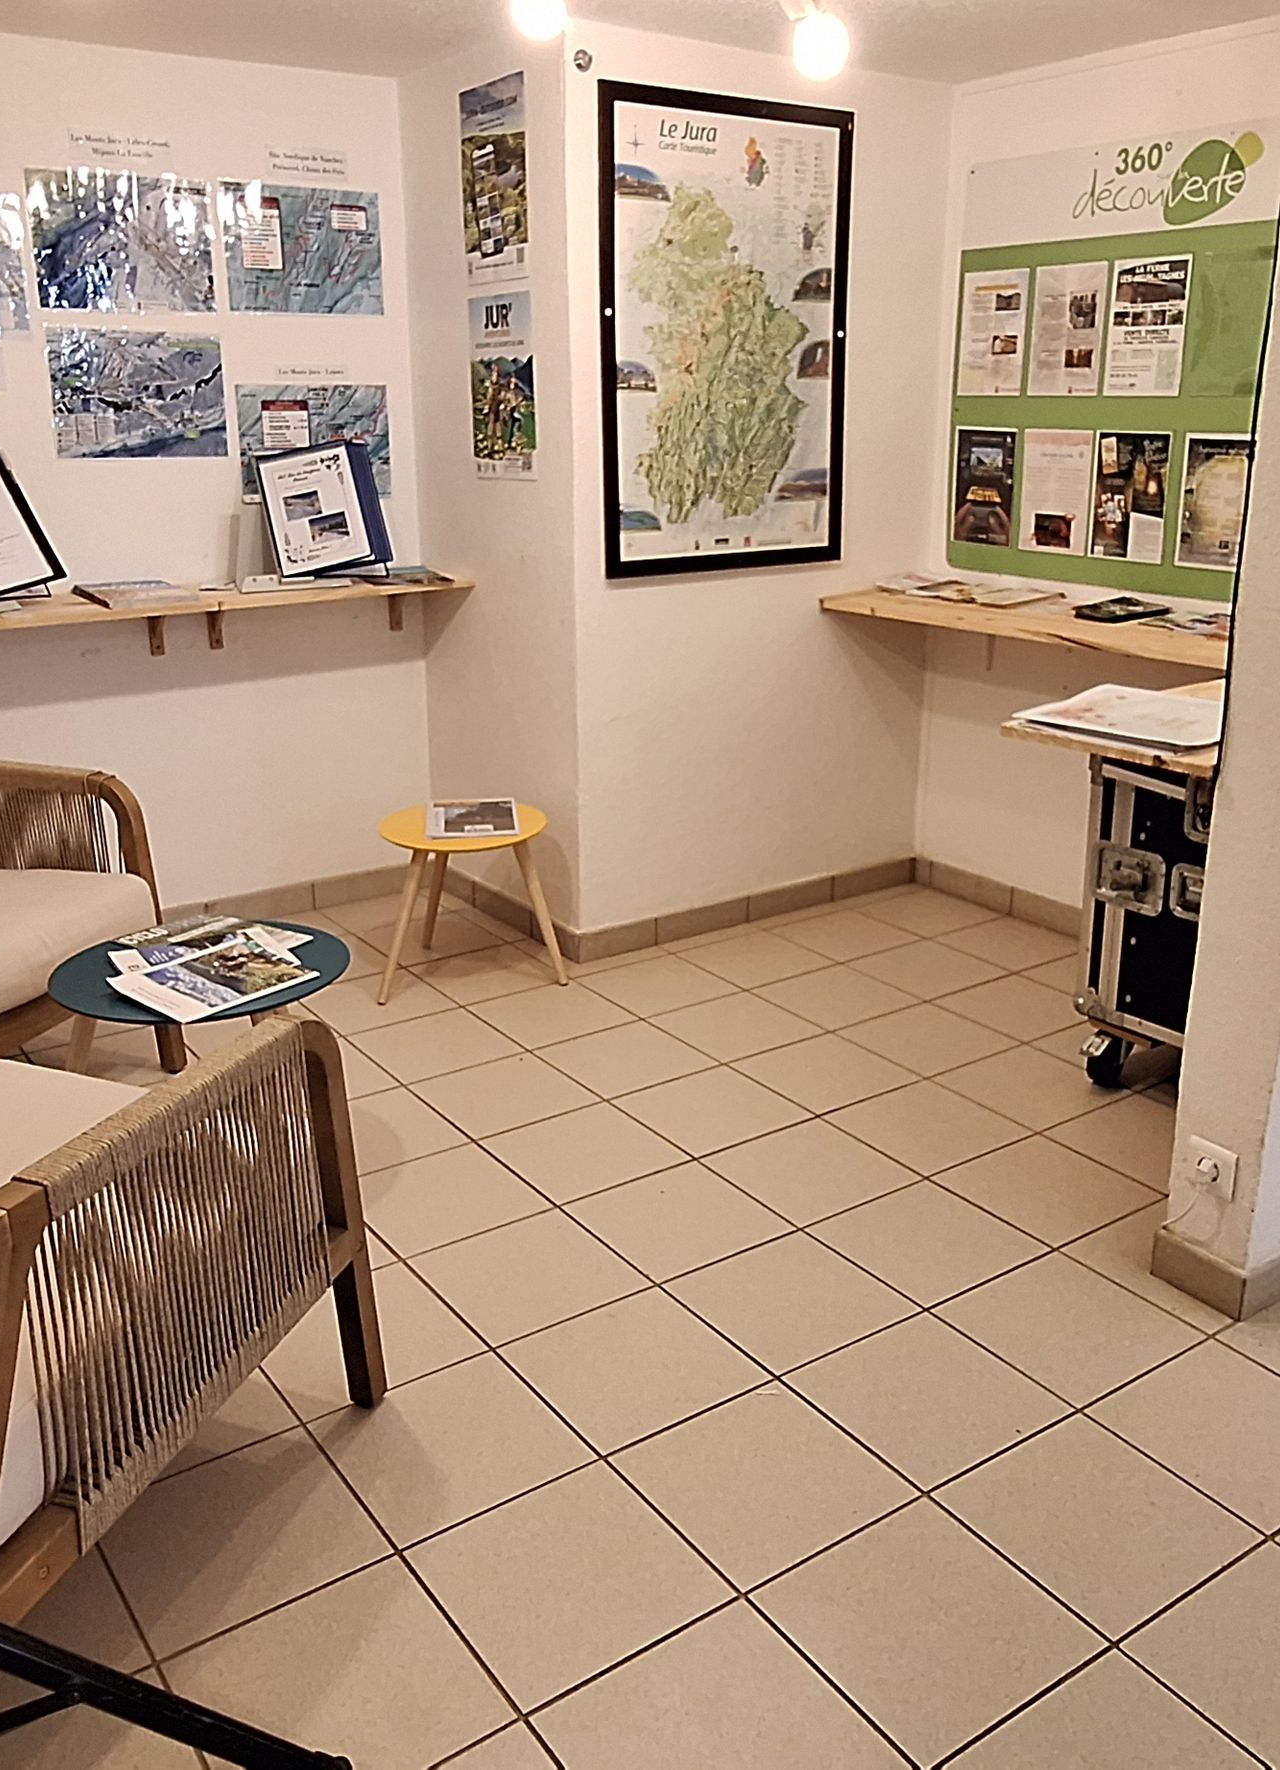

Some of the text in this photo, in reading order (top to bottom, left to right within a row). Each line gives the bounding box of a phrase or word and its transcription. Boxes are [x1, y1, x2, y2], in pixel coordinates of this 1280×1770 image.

[659, 119, 718, 142] Le Jura
[659, 141, 678, 150] Carte
[1115, 141, 1174, 175] 360°
